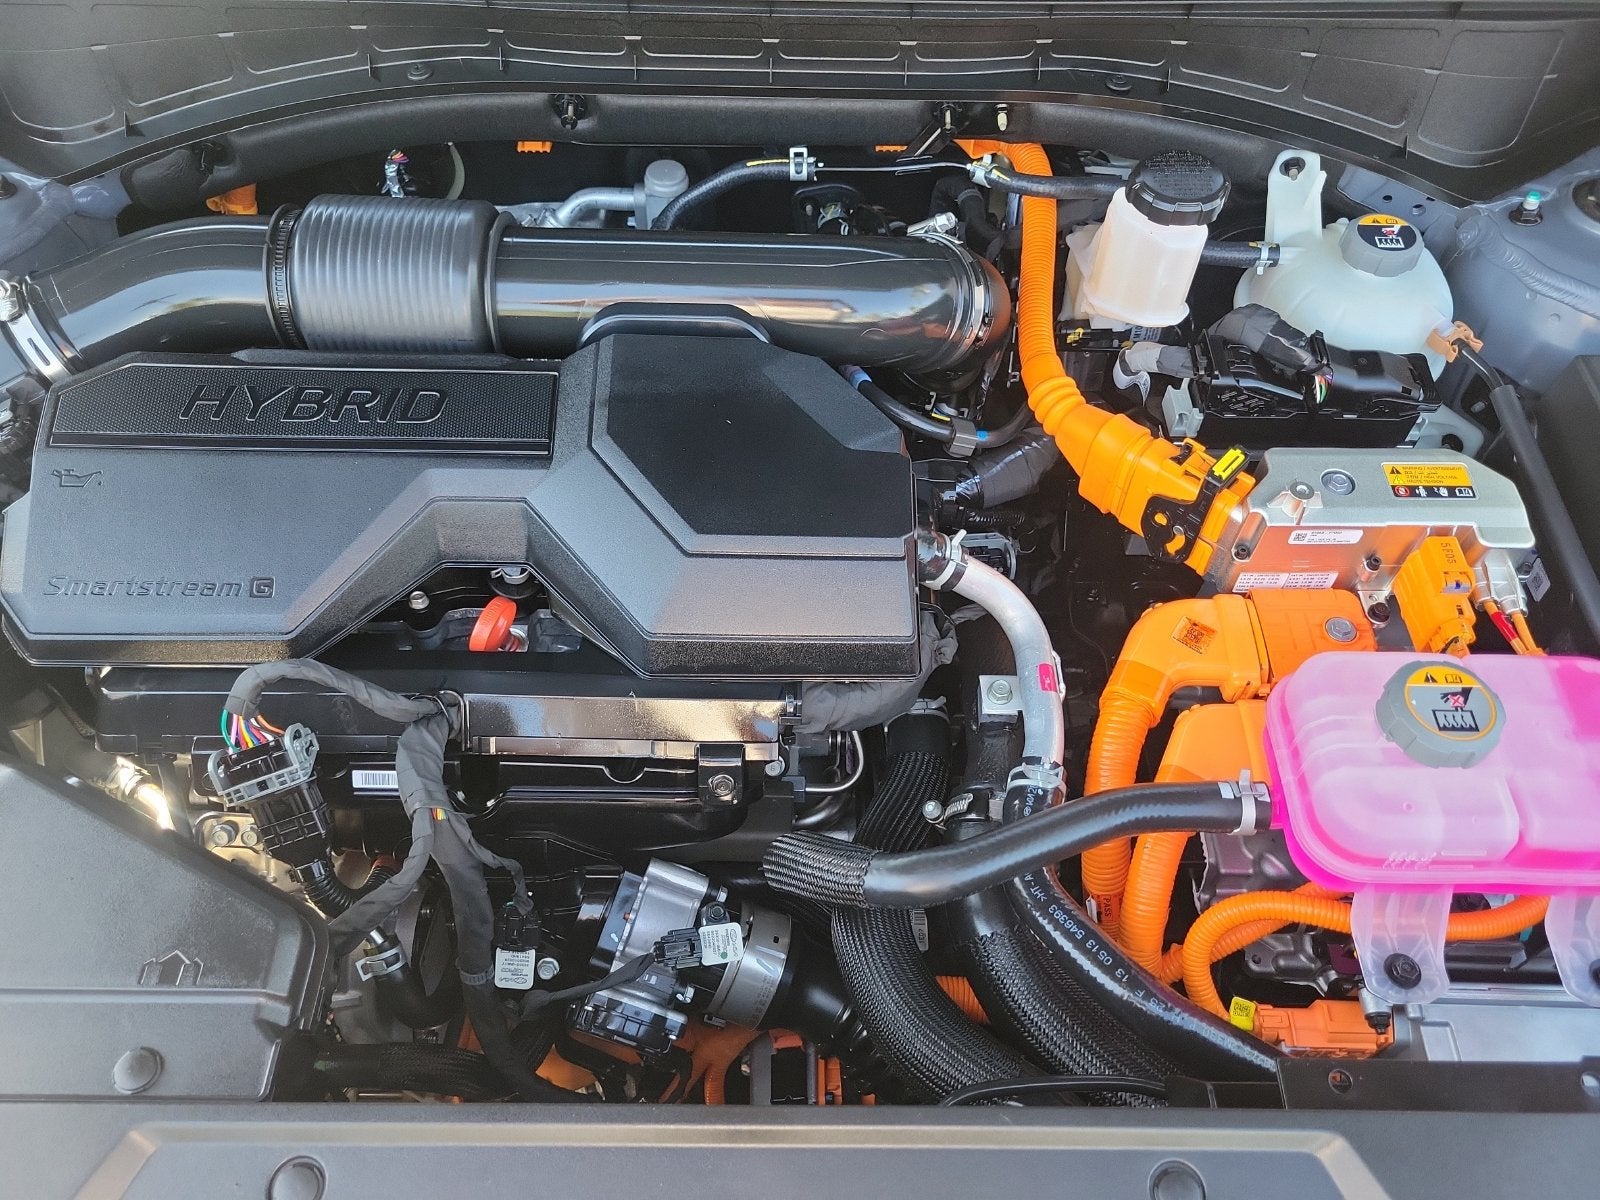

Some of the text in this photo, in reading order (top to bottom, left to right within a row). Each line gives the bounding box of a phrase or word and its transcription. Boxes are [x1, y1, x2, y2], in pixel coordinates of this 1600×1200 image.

[178, 383, 449, 425] HYBRID
[43, 575, 274, 598] Smartstream G
[1103, 897, 1112, 918] PASS
[1049, 904, 1086, 940] 546393
[1115, 968, 1129, 982] 13
[1135, 989, 1146, 998] F
